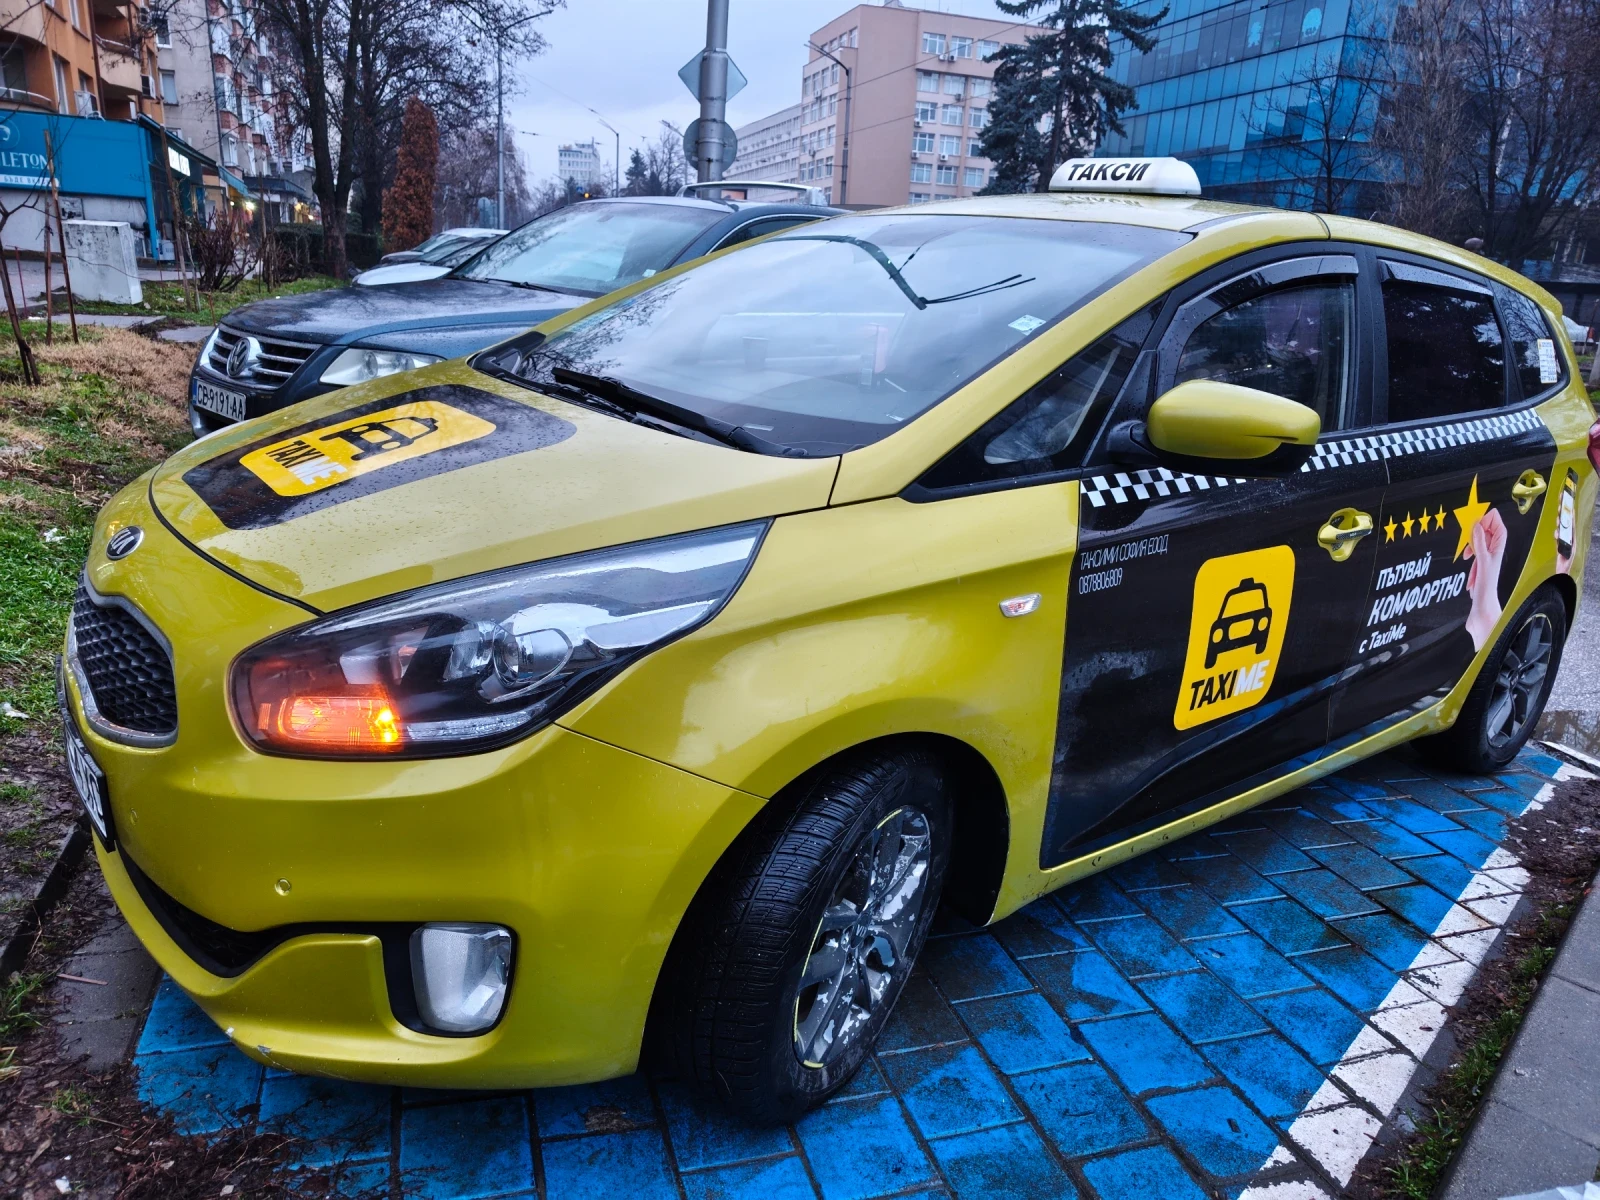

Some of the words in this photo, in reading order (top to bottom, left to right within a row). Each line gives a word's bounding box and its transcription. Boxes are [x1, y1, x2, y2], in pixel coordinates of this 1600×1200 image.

[1067, 163, 1152, 181] ТАКСИ
[1375, 551, 1432, 590] ПЪТУВАЙ
[1366, 571, 1466, 627] КОМФОРТНО
[1368, 622, 1407, 650] TaxiMe
